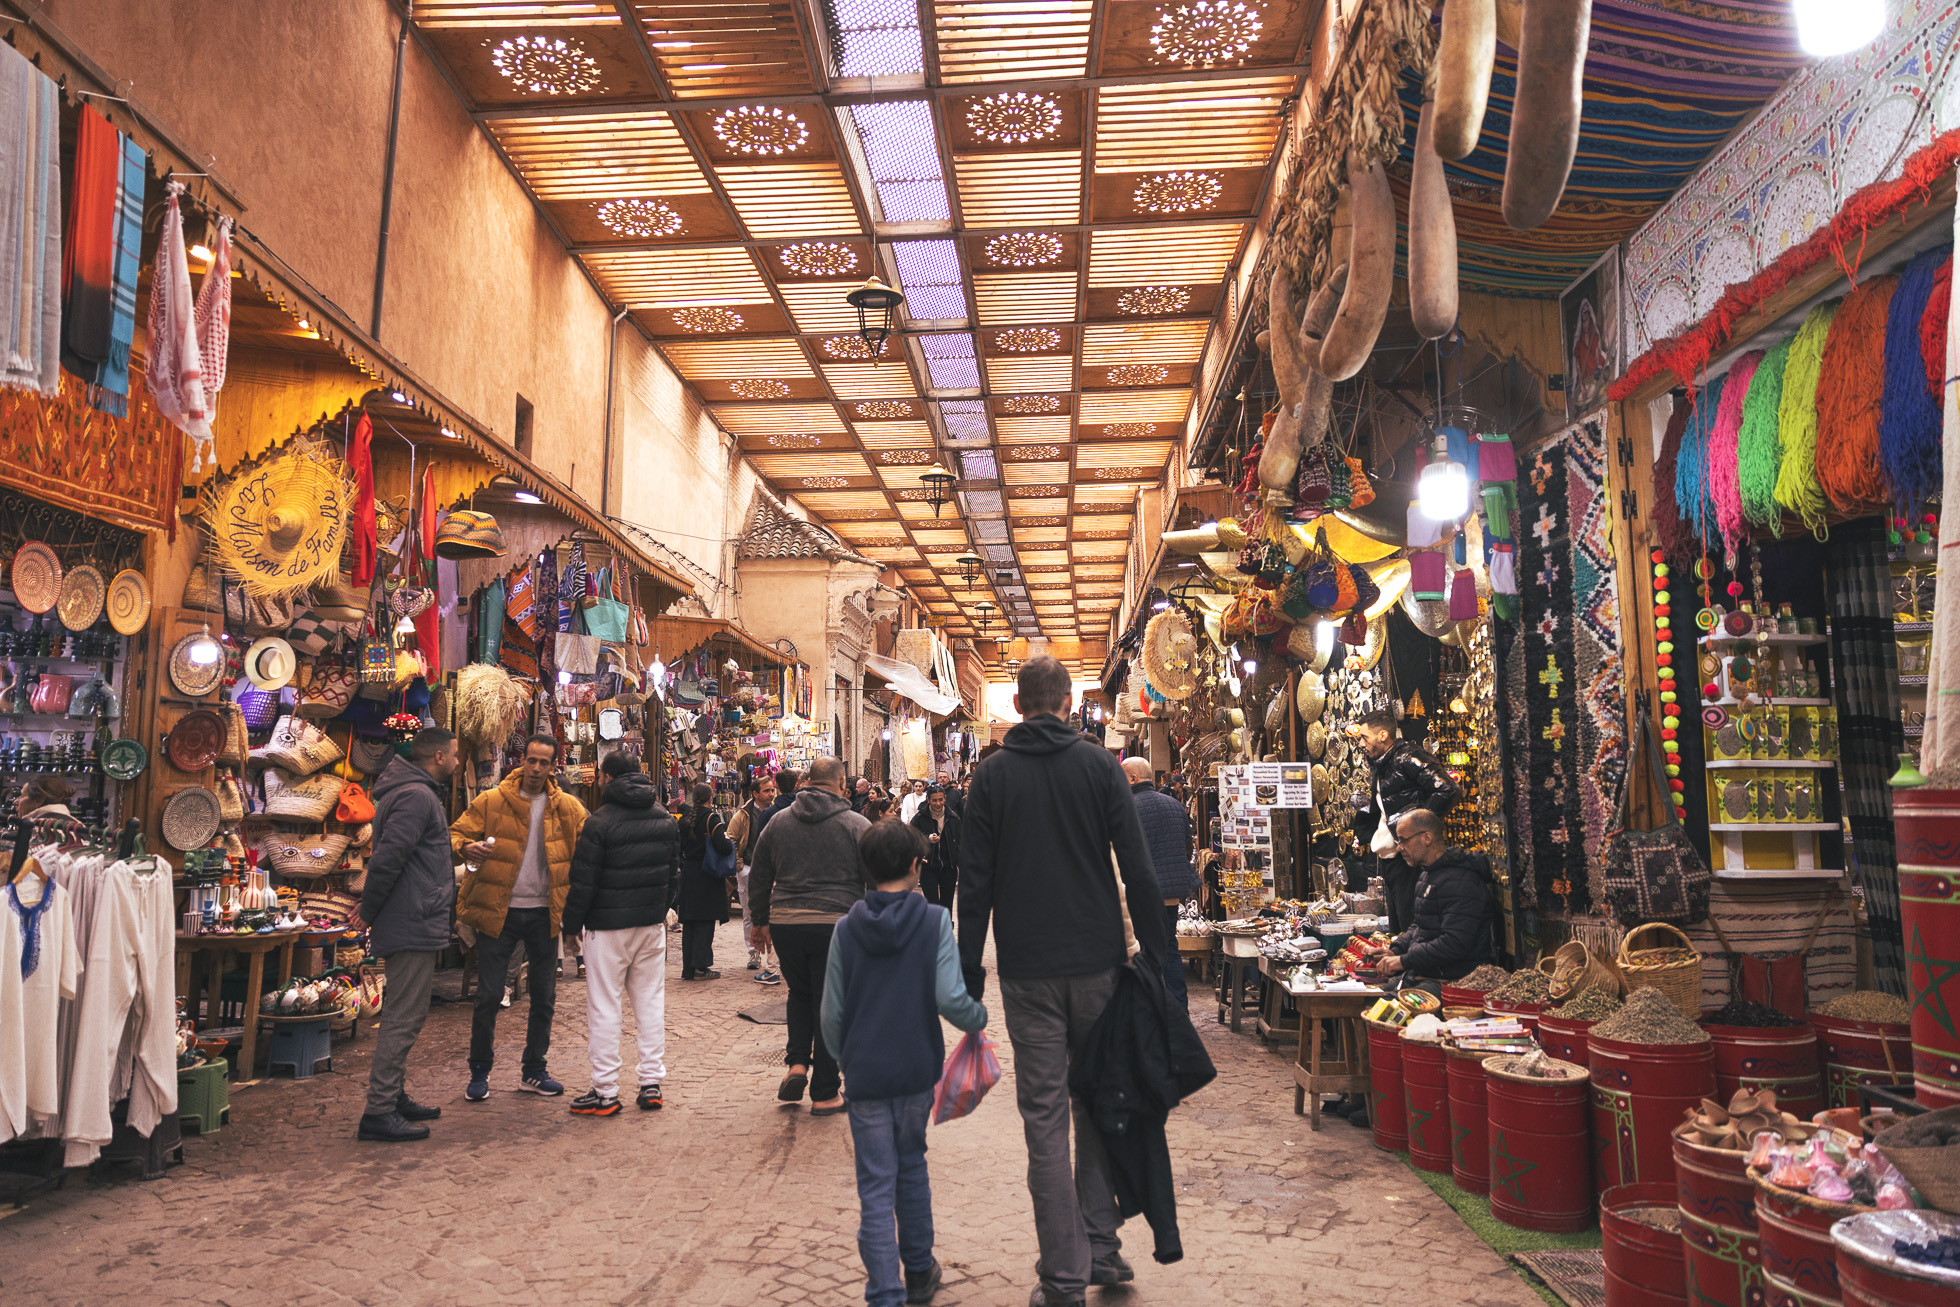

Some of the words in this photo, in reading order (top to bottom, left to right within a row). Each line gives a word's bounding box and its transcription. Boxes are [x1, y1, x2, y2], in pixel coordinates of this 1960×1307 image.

[239, 472, 275, 506] La
[229, 506, 284, 576] Maison
[305, 490, 340, 565] Famille
[288, 551, 309, 577] de
